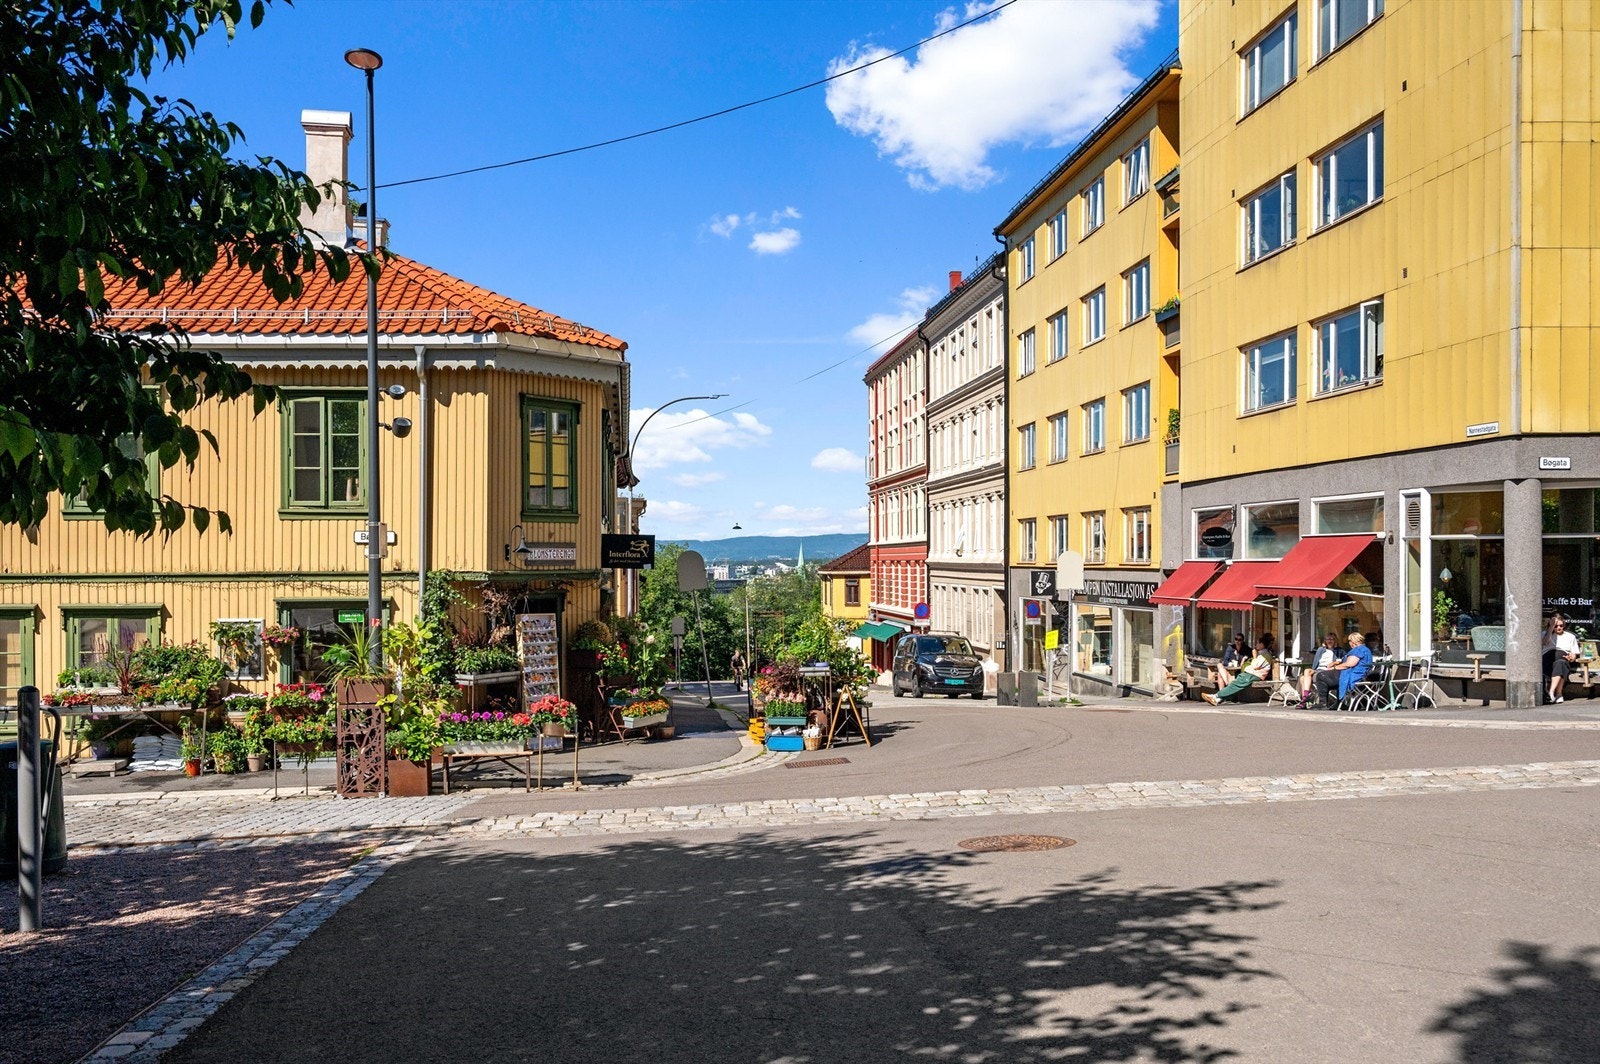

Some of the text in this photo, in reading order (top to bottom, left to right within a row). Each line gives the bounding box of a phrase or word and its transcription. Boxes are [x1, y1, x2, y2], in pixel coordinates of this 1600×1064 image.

[1542, 458, 1567, 467] Bøgata
[609, 550, 640, 558] Interflora
[1101, 582, 1145, 601] INSTALLASJON
[1146, 584, 1155, 599] AS
[1547, 597, 1569, 605] Kaffe
[1570, 597, 1577, 605] &
